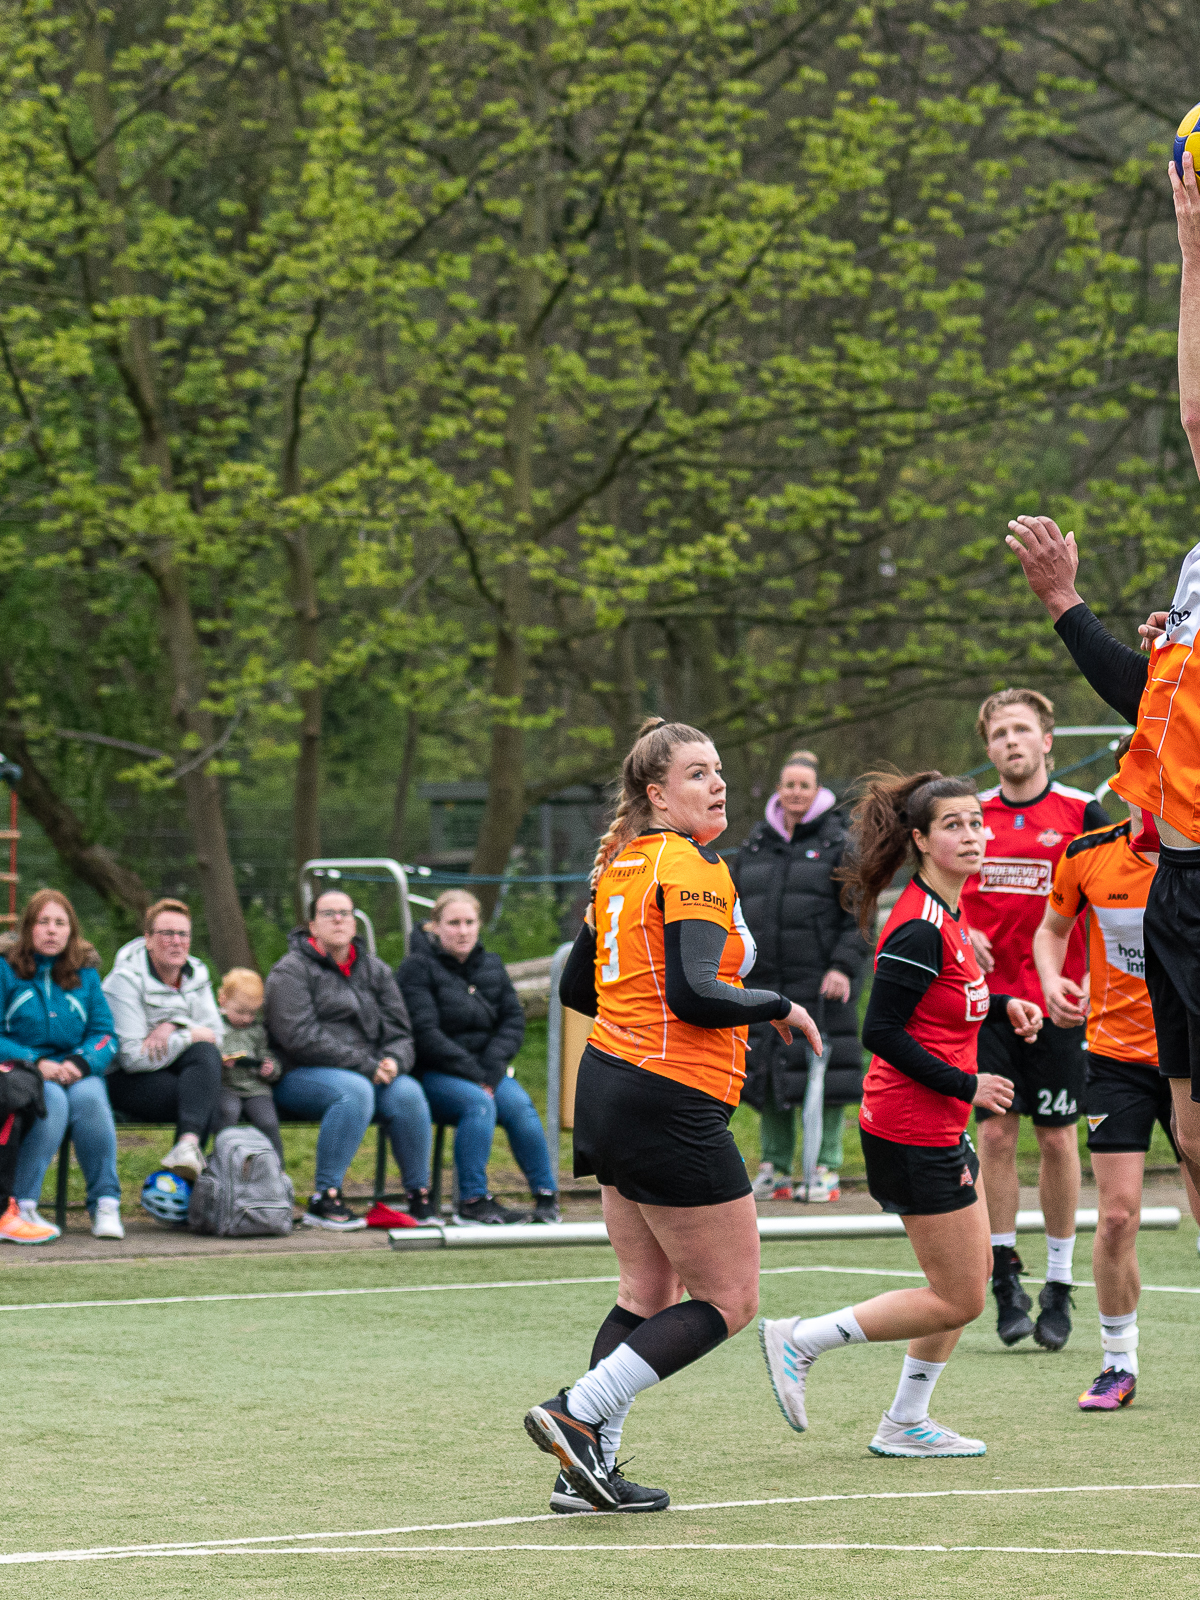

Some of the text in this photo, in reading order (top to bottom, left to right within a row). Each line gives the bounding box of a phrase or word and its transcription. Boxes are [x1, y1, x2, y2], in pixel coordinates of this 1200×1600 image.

[680, 890, 700, 902] De
[703, 890, 728, 911] Bink
[1107, 893, 1129, 901] JAKO
[601, 895, 625, 983] 3
[1118, 943, 1145, 960] hou
[1127, 959, 1144, 973] int
[1038, 1089, 1069, 1116] 24
